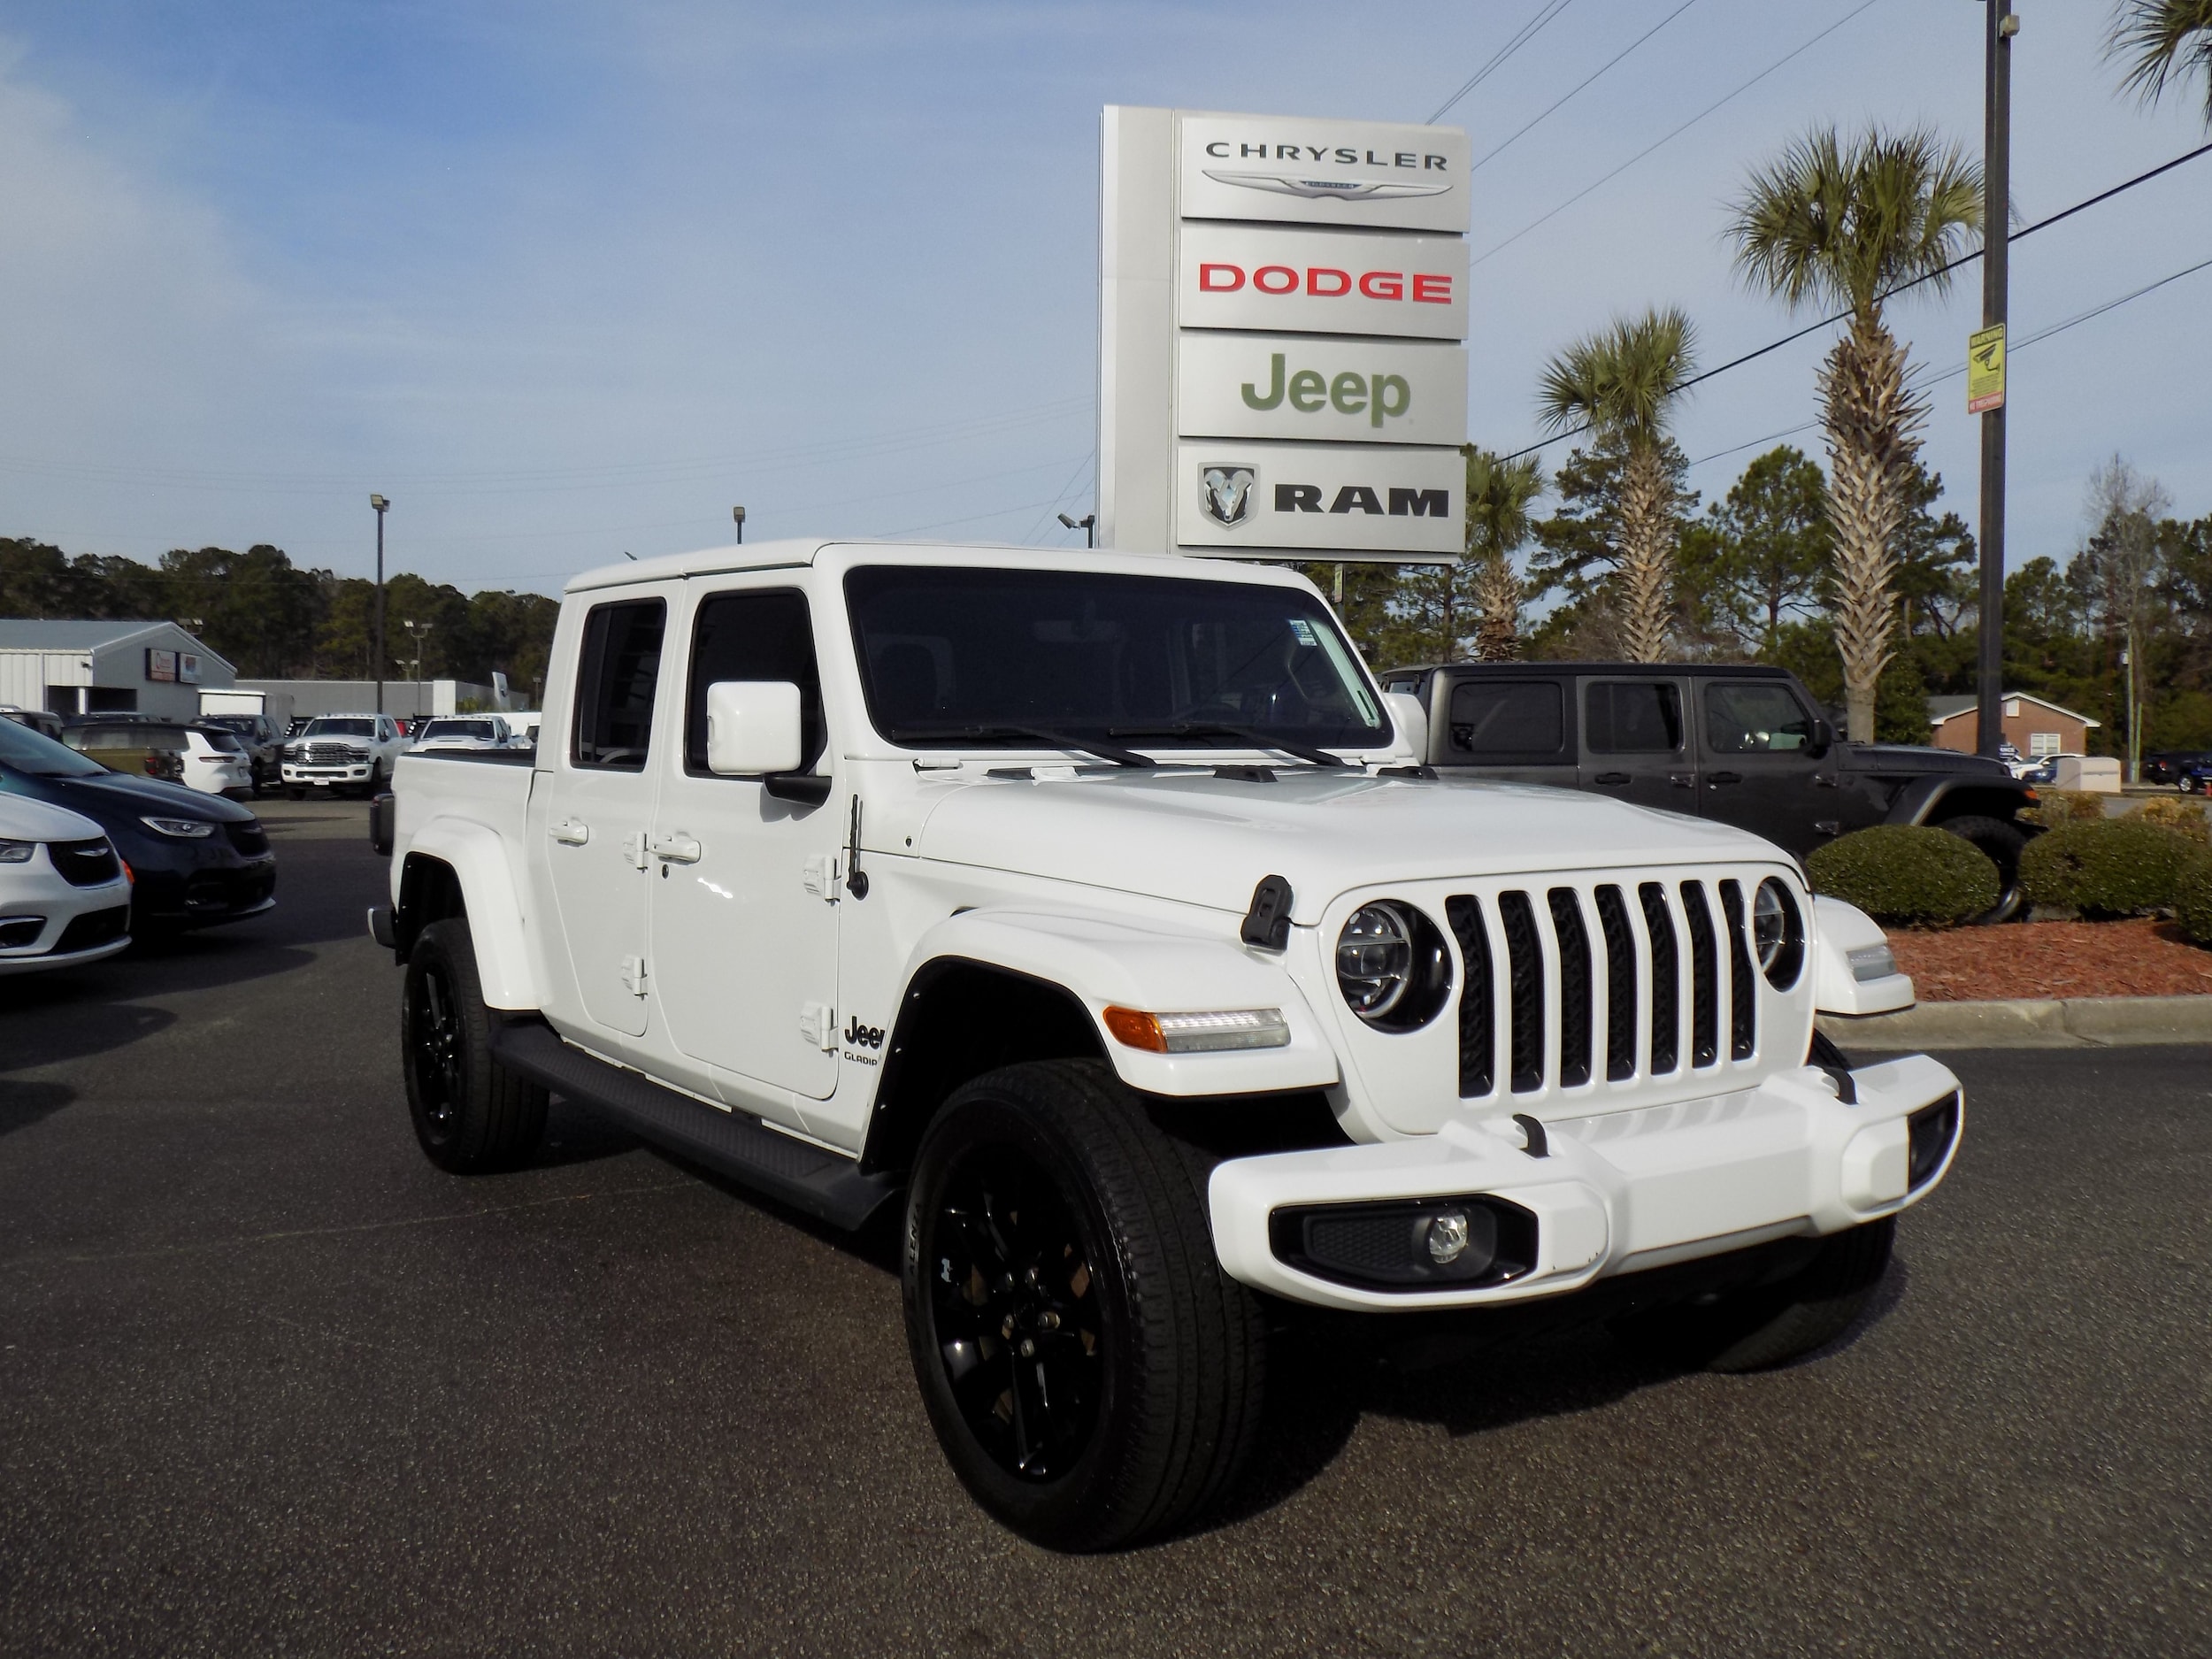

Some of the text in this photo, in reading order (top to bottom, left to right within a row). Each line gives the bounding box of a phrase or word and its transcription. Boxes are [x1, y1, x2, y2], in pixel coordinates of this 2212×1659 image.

[1206, 142, 1448, 172] CHRYSLER
[1199, 263, 1453, 304] DODGE
[1240, 353, 1411, 427] Jeep
[1274, 483, 1450, 518] RAM
